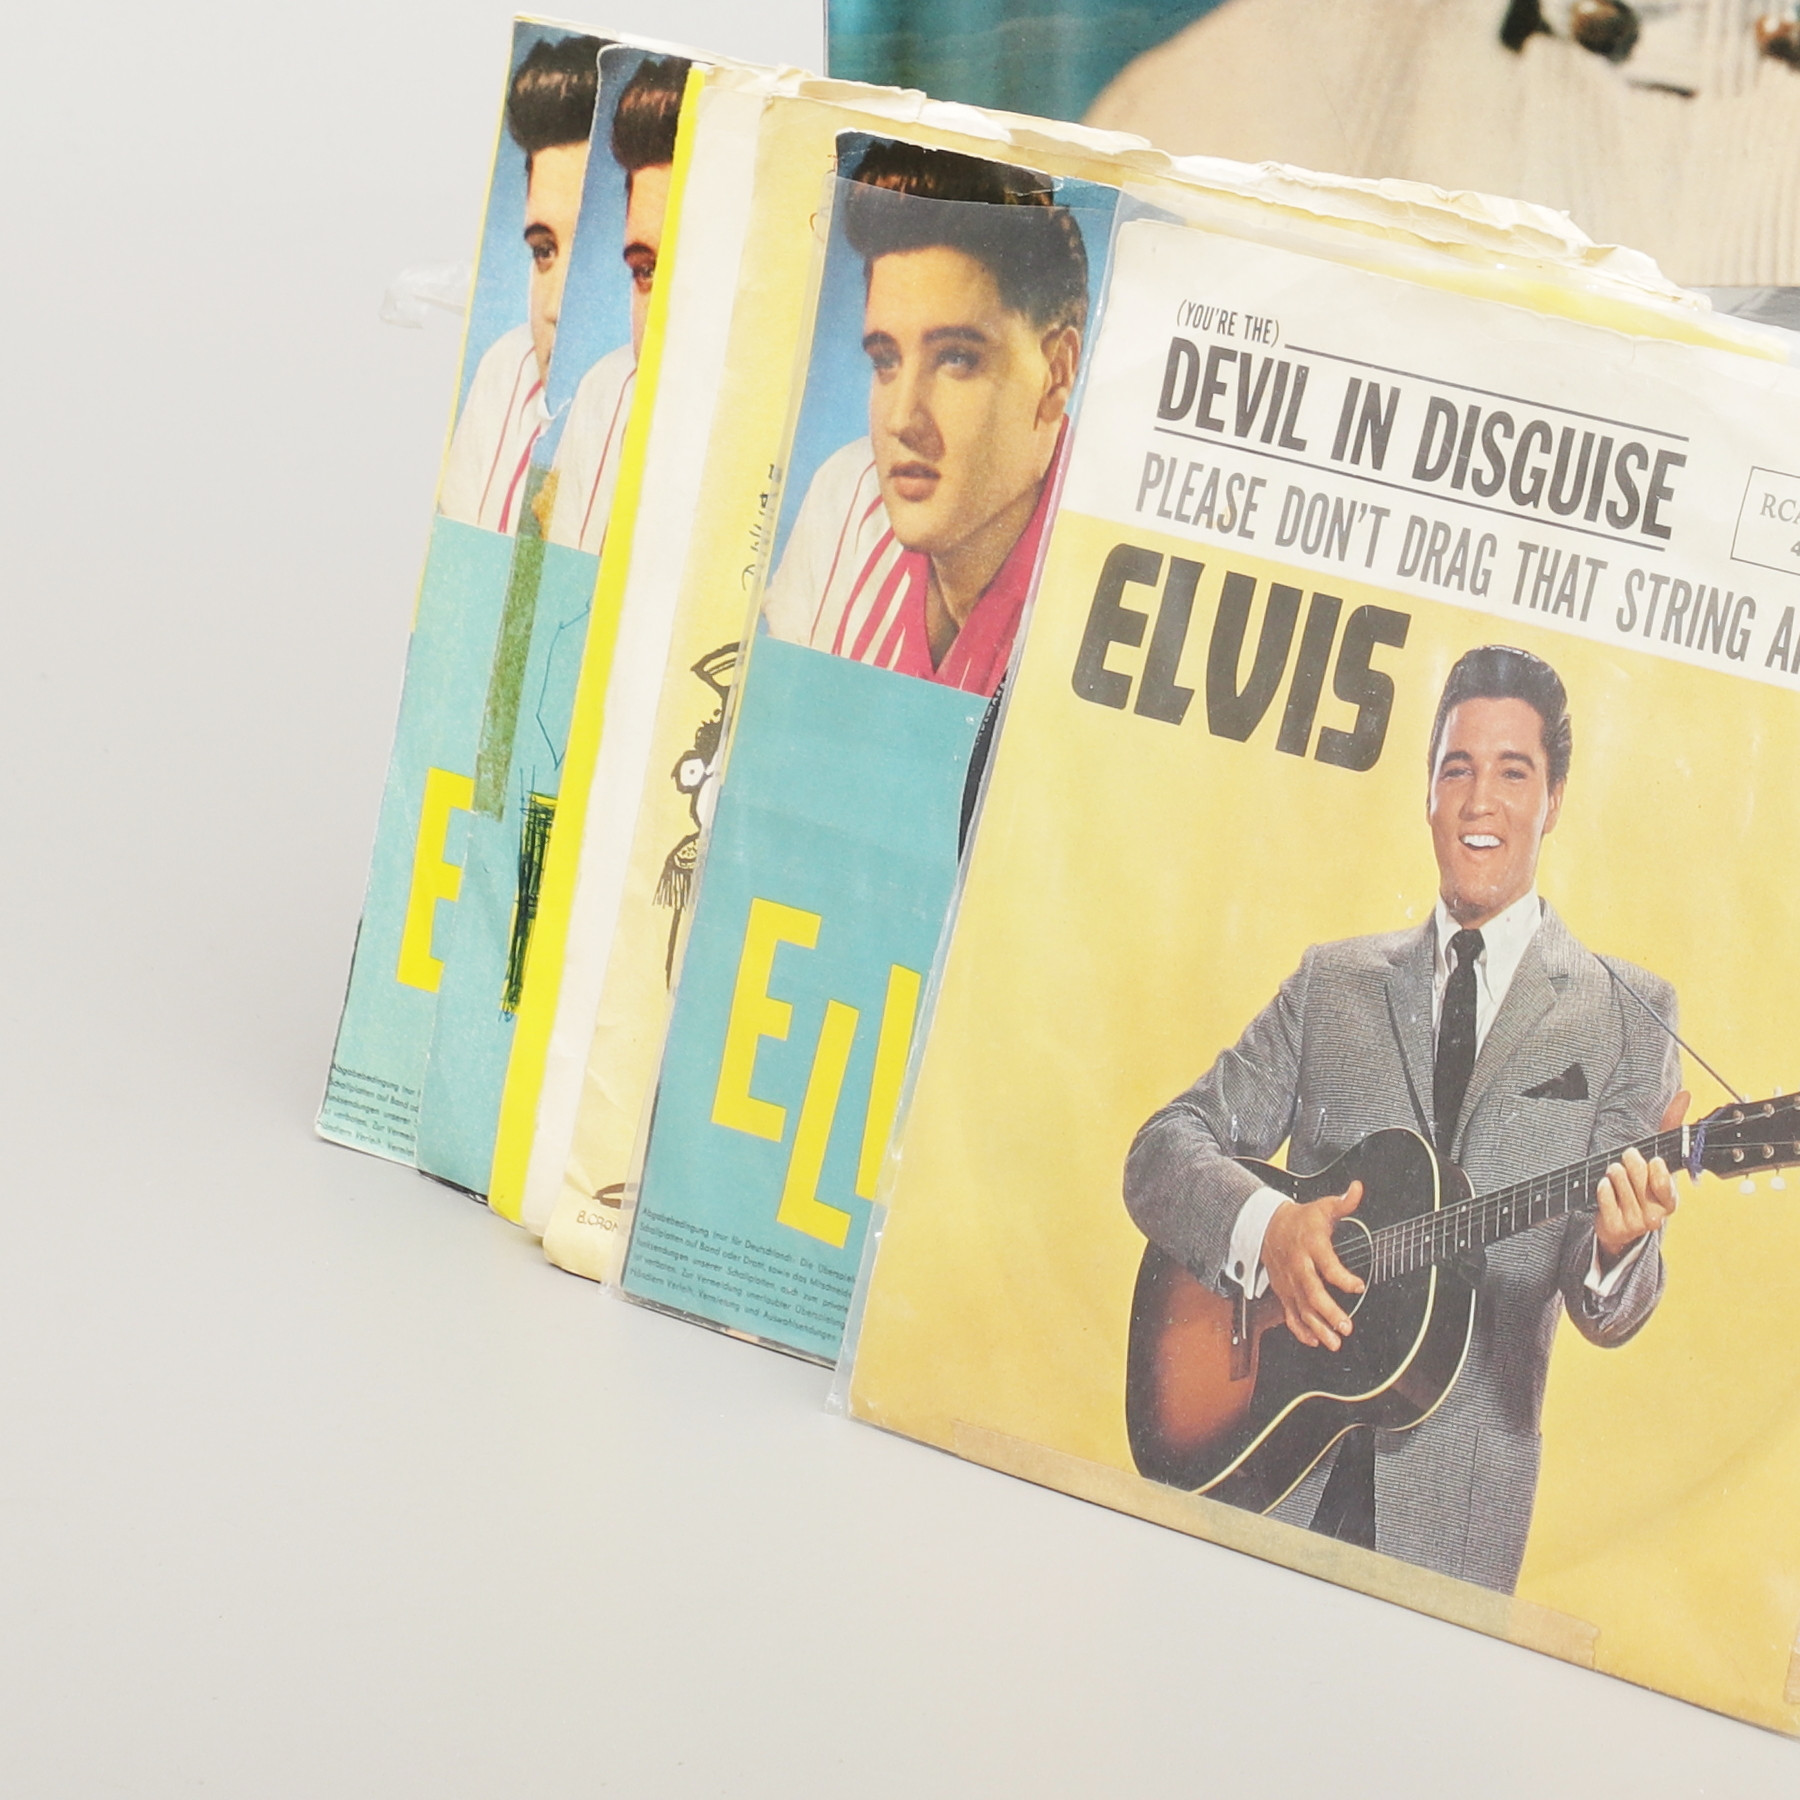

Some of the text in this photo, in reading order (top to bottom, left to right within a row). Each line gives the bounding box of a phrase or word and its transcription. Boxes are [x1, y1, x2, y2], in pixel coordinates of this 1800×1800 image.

[1176, 298, 1280, 347] (YOU'RE THE)
[1156, 336, 1687, 540] DEVIL IN DISGUISE
[1072, 542, 1412, 772] ELVIS
[1135, 451, 1267, 539] PLEASE
[1275, 484, 1390, 568] DON'T
[1397, 515, 1497, 597] DRAG
[1512, 540, 1608, 622] THAT
[1615, 567, 1757, 662] STRING
